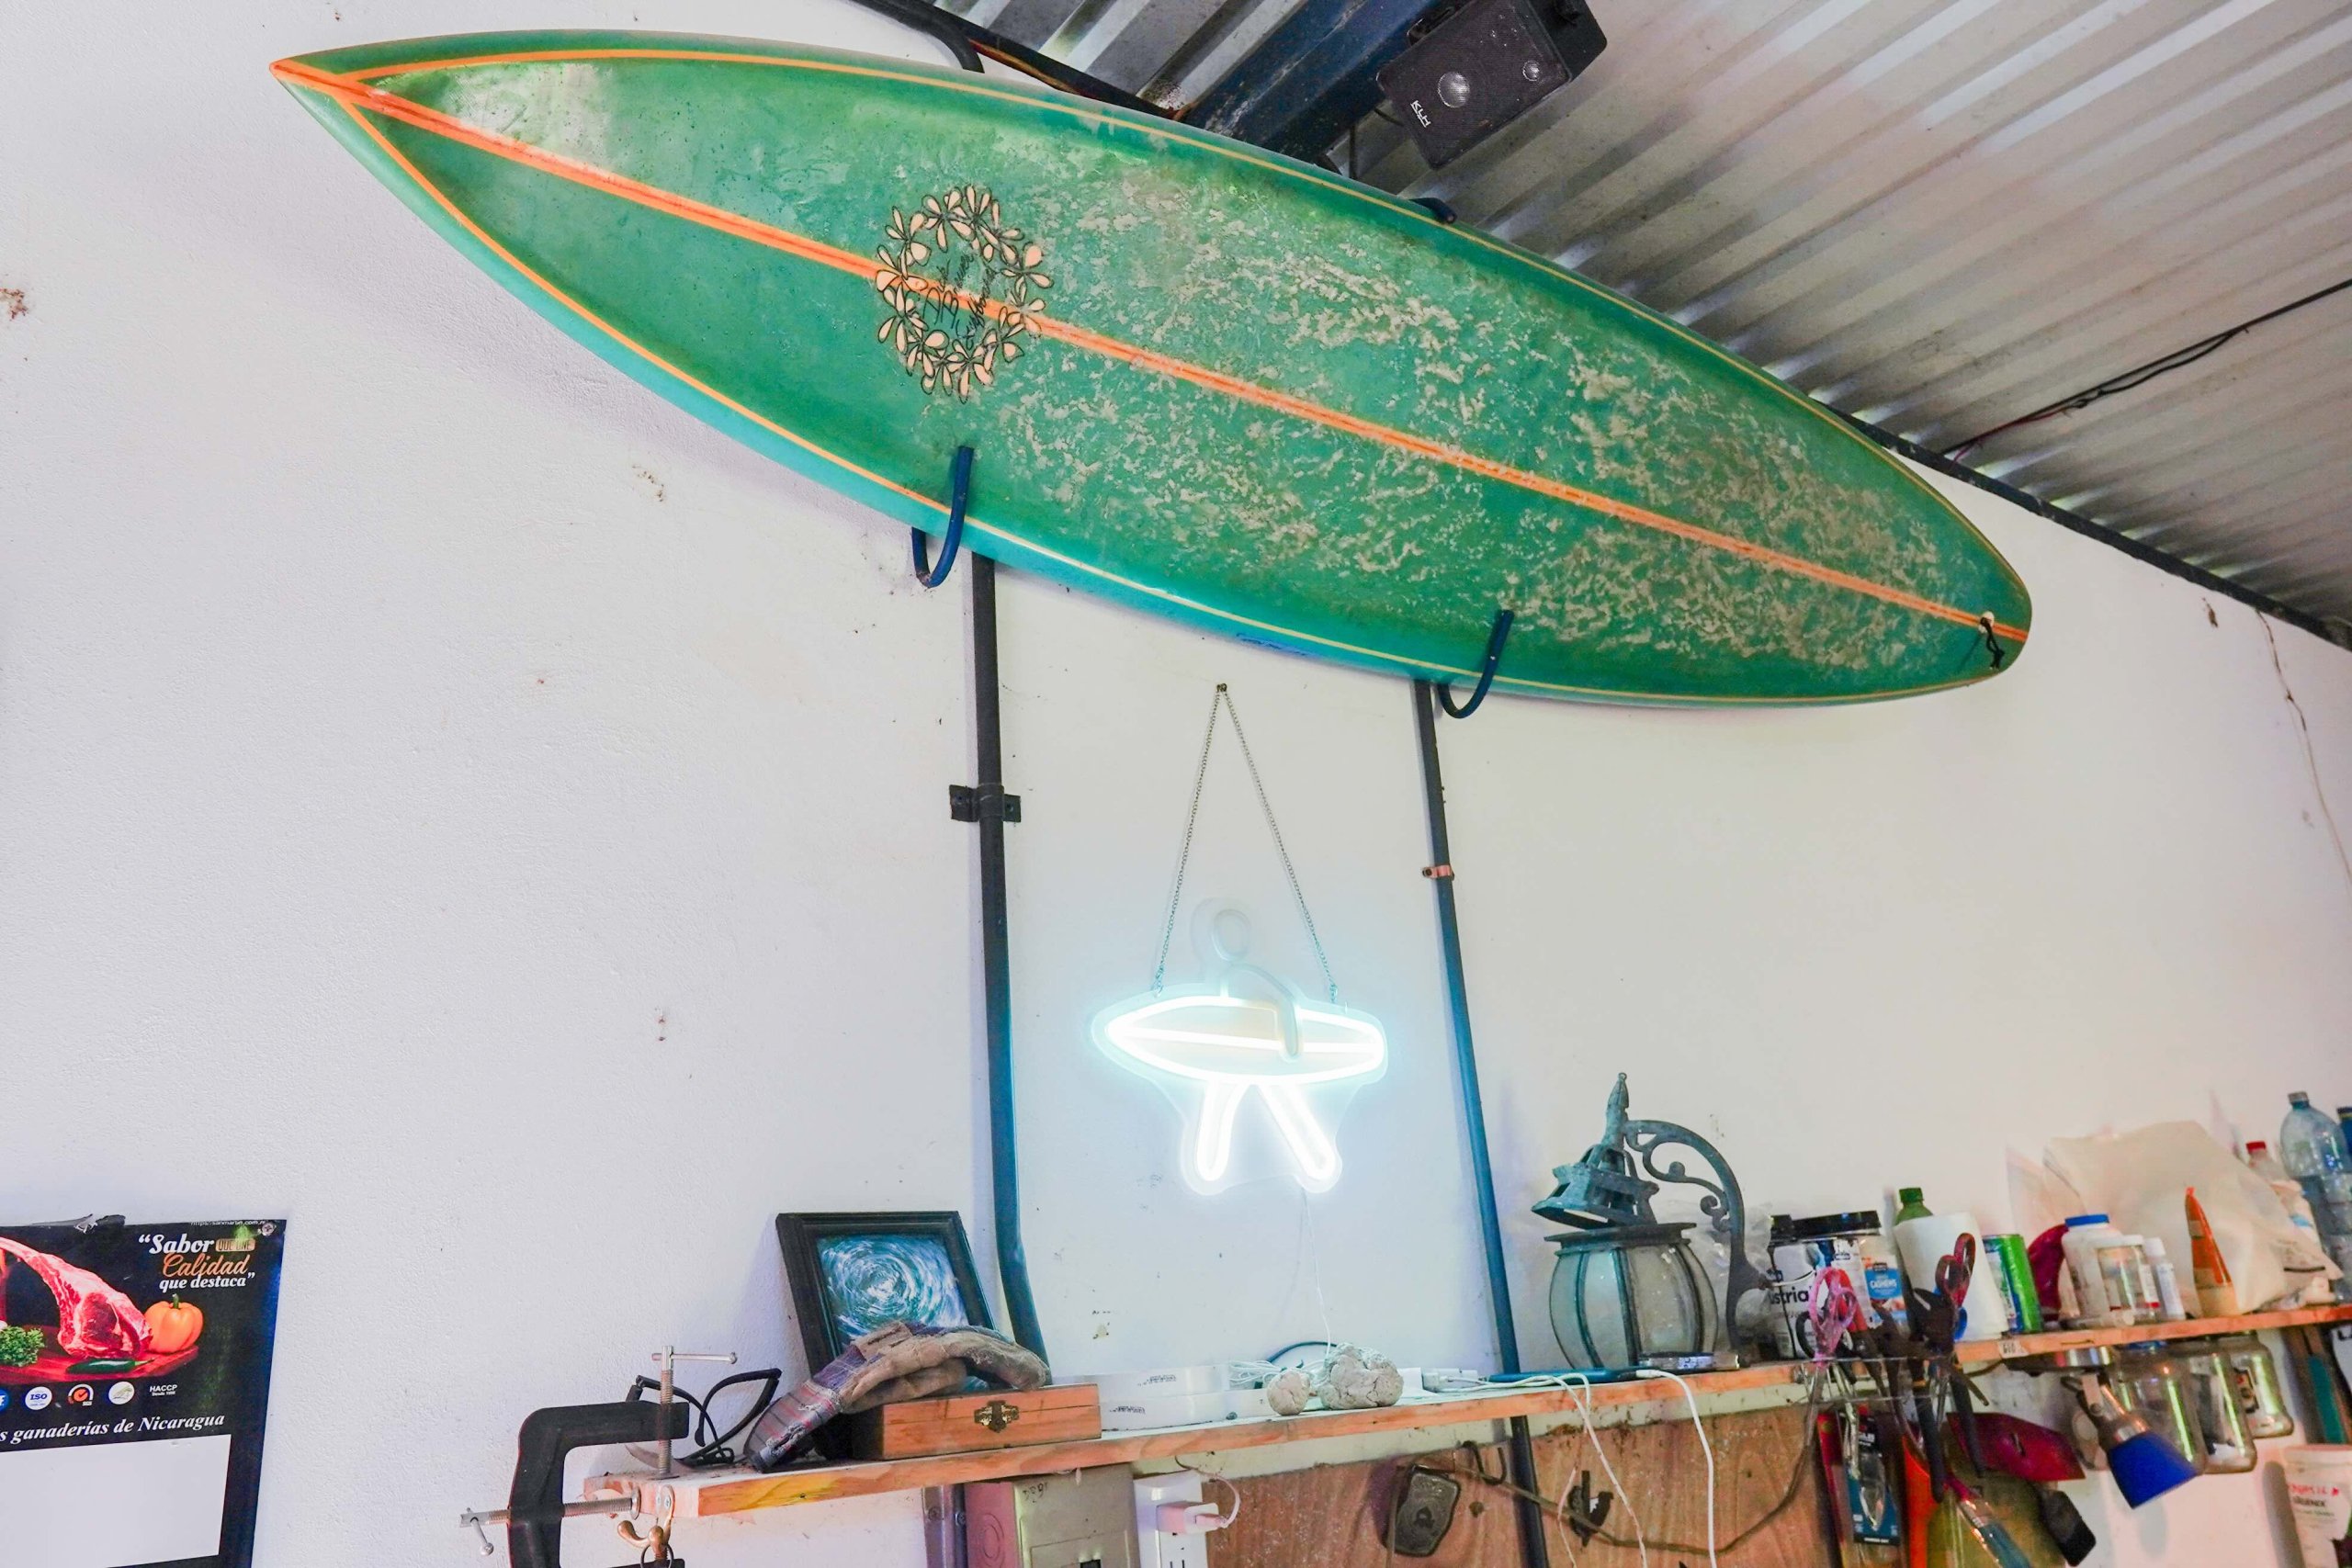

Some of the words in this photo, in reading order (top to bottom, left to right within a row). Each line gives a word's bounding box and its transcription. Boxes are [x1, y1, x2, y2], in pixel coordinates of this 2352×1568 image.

[1410, 100, 1431, 128] KLH
[162, 1253, 251, 1278] Calidad
[159, 1278, 187, 1292] que
[149, 1383, 178, 1393] HACCP
[10, 1421, 109, 1445] ganaderías
[113, 1419, 134, 1433] de
[137, 1415, 225, 1432] Nicaragua
